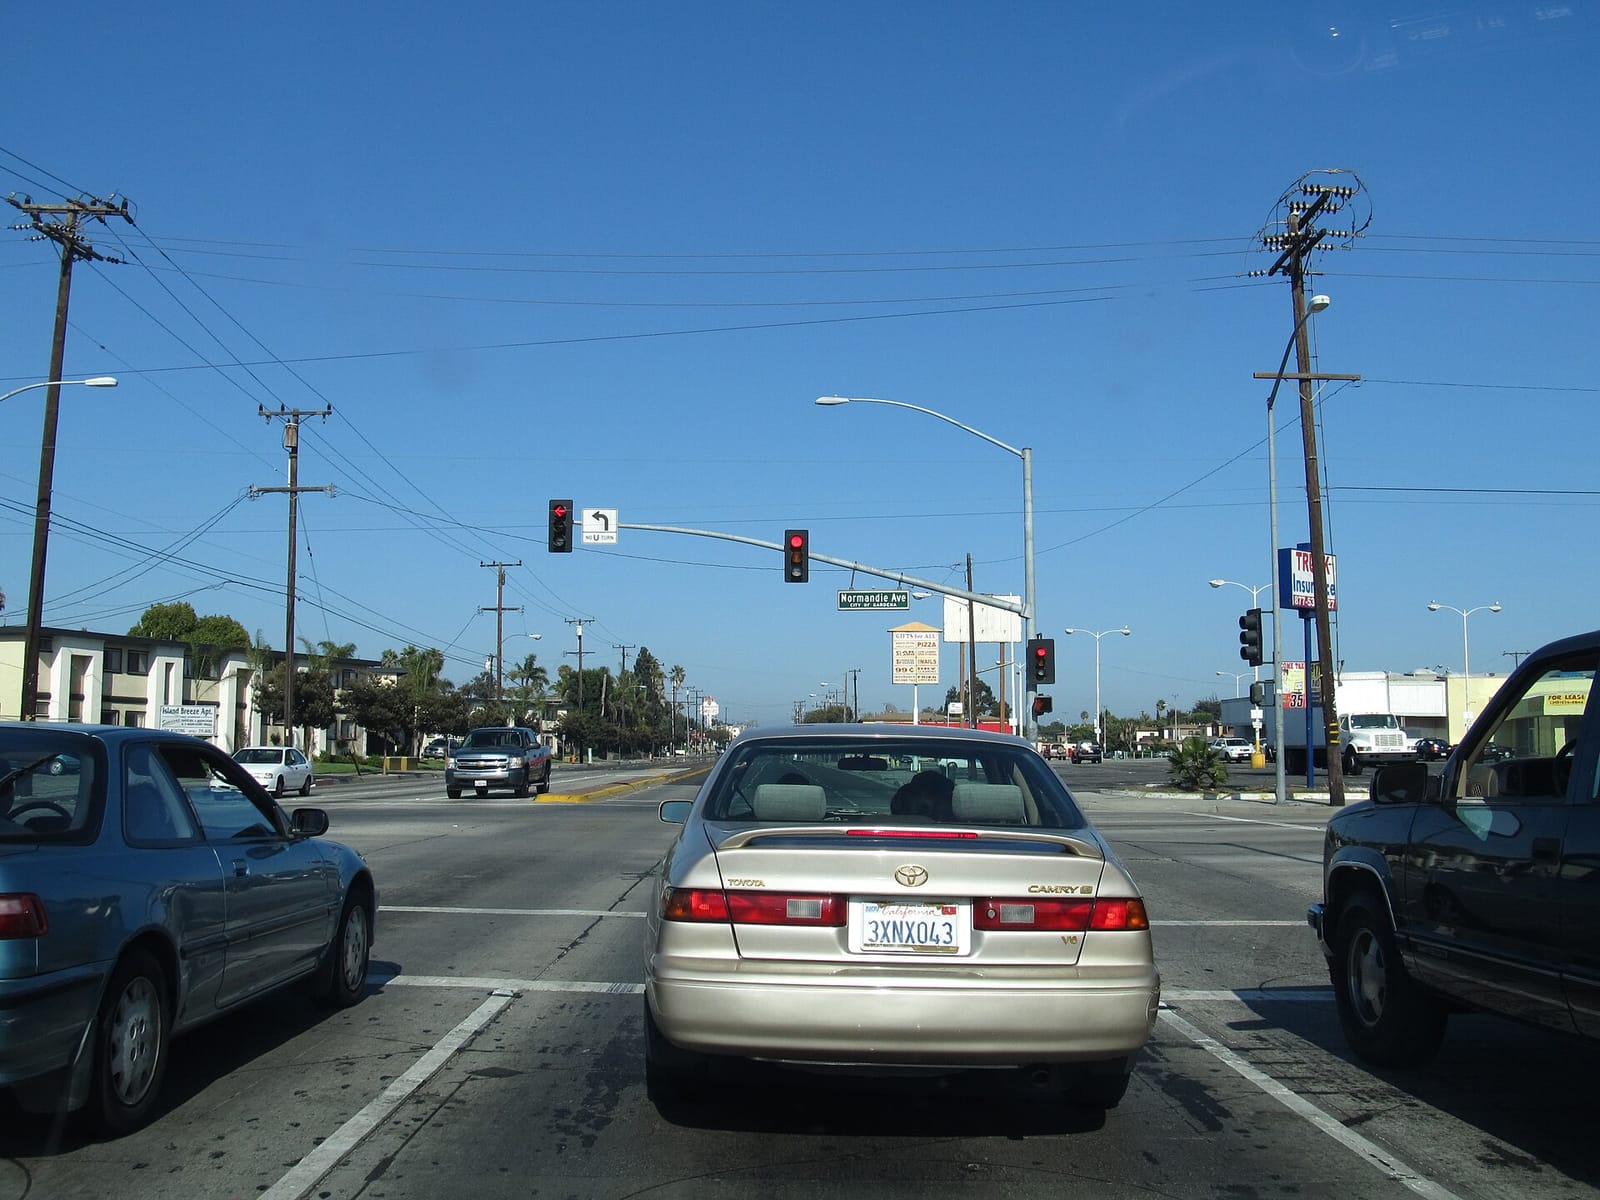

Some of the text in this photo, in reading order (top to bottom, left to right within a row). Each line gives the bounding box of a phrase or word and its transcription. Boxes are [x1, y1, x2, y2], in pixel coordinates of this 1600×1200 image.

[1295, 551, 1330, 575] TRUK
[841, 593, 906, 602] Normandie Ave
[728, 878, 766, 887] TOYOTA
[1027, 885, 1079, 894] CAMRY
[882, 904, 941, 918] California
[868, 920, 953, 944] 3XNX043
[1061, 935, 1078, 945] V6
